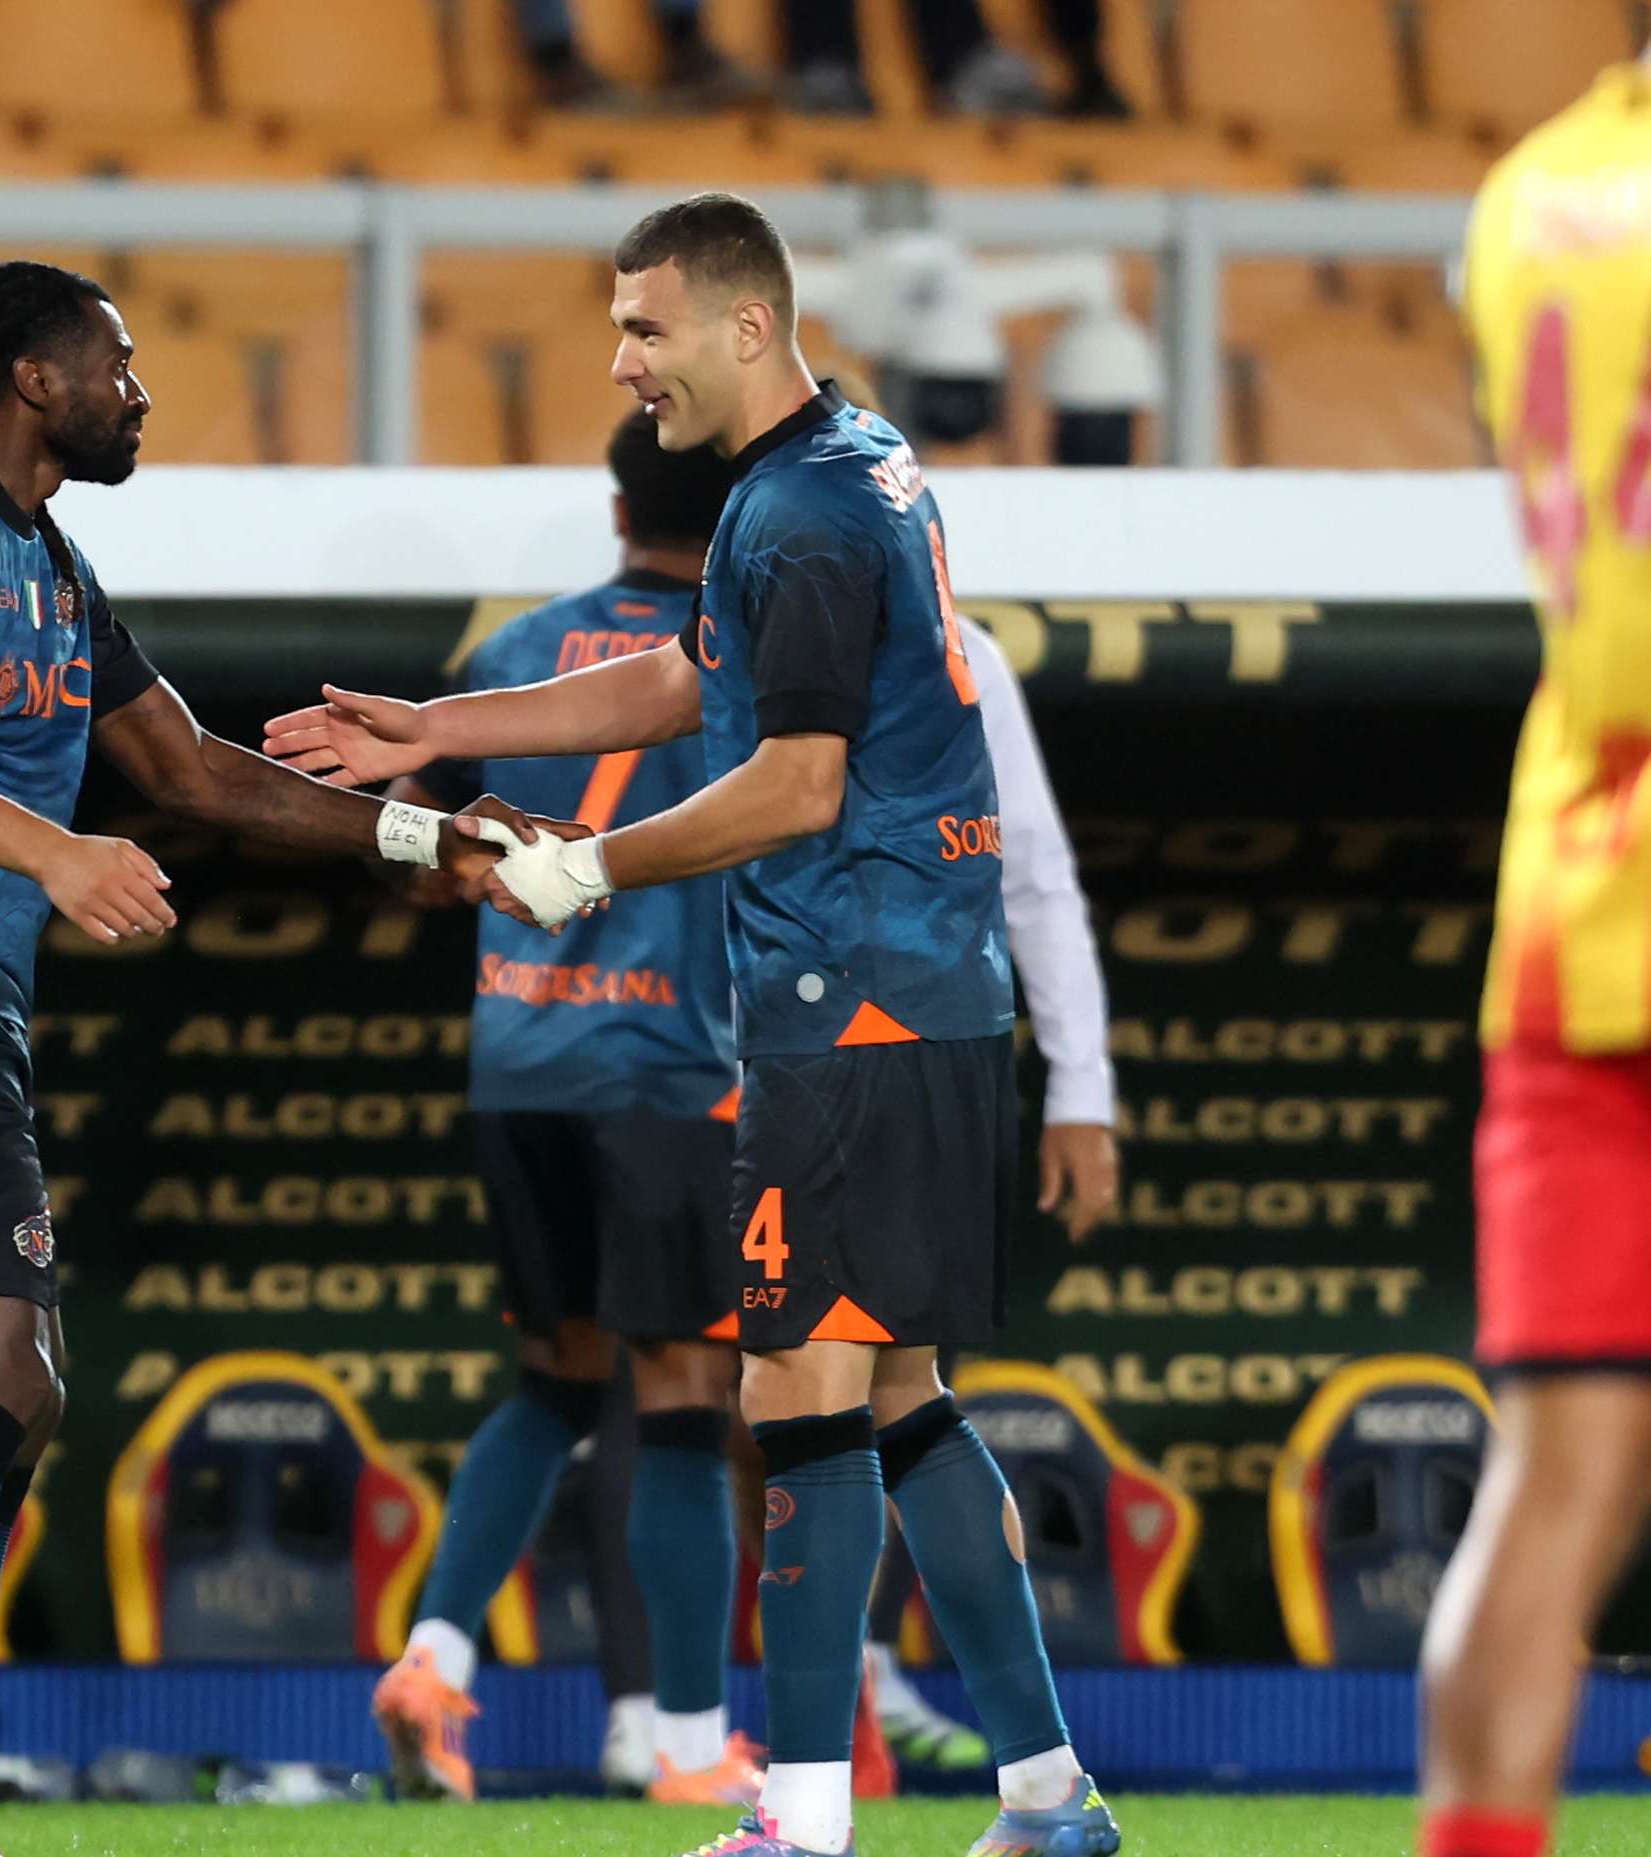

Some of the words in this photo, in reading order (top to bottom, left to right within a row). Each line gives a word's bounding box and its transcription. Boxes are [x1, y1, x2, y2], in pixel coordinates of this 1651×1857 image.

[164, 1013, 471, 1057] ALCOT
[150, 1091, 468, 1139] ALCOT
[741, 1187, 789, 1279] 4
[122, 1262, 502, 1312] ALCOTT
[743, 1287, 787, 1309] EA7
[1048, 1266, 1423, 1316] ALCOTT
